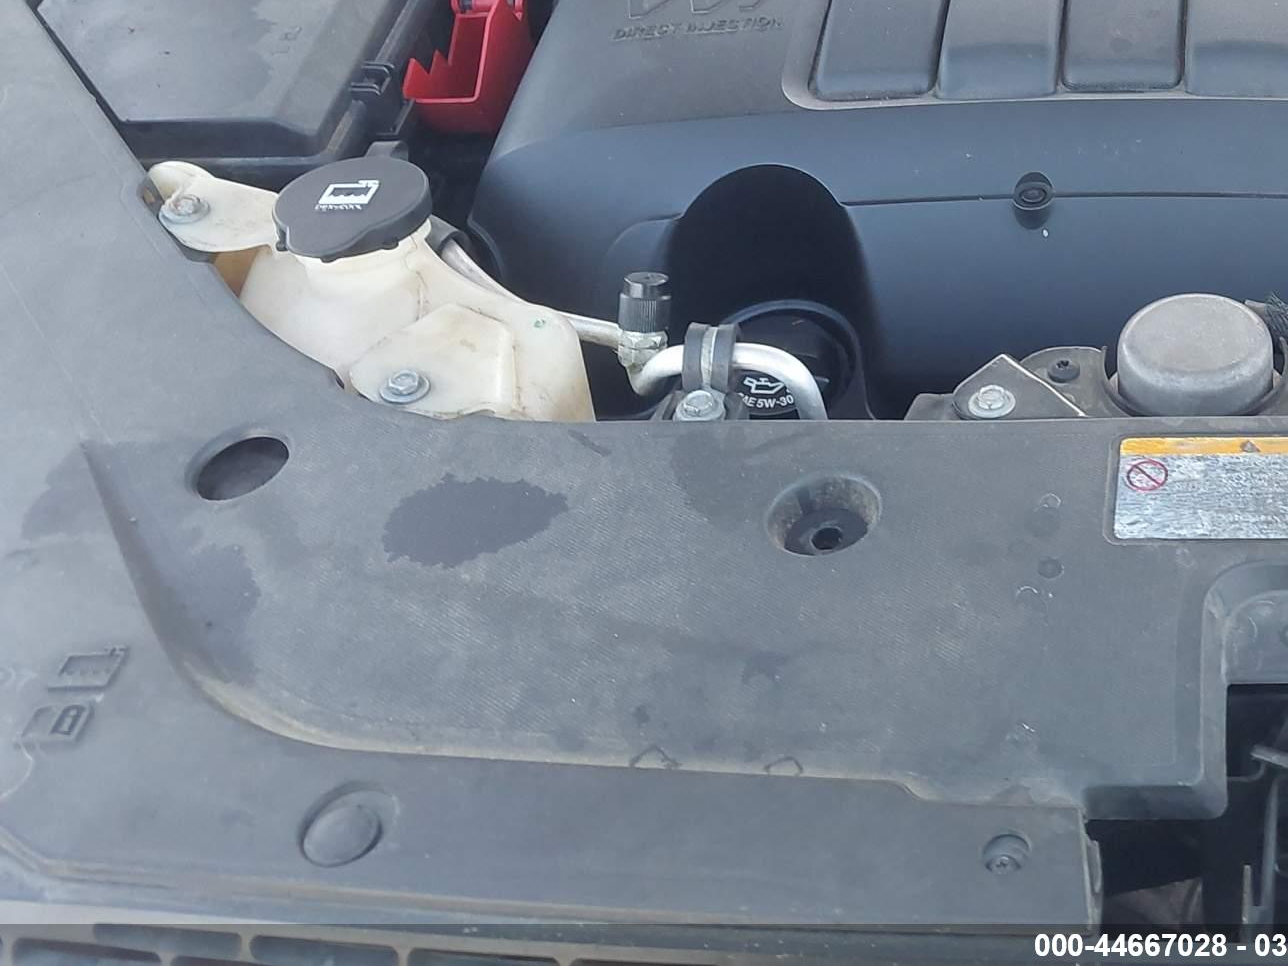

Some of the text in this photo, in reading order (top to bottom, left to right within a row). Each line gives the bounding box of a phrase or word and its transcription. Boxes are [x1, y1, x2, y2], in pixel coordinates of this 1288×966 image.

[613, 17, 784, 41] DIRECT INJECTION
[756, 393, 794, 408] 5W-30
